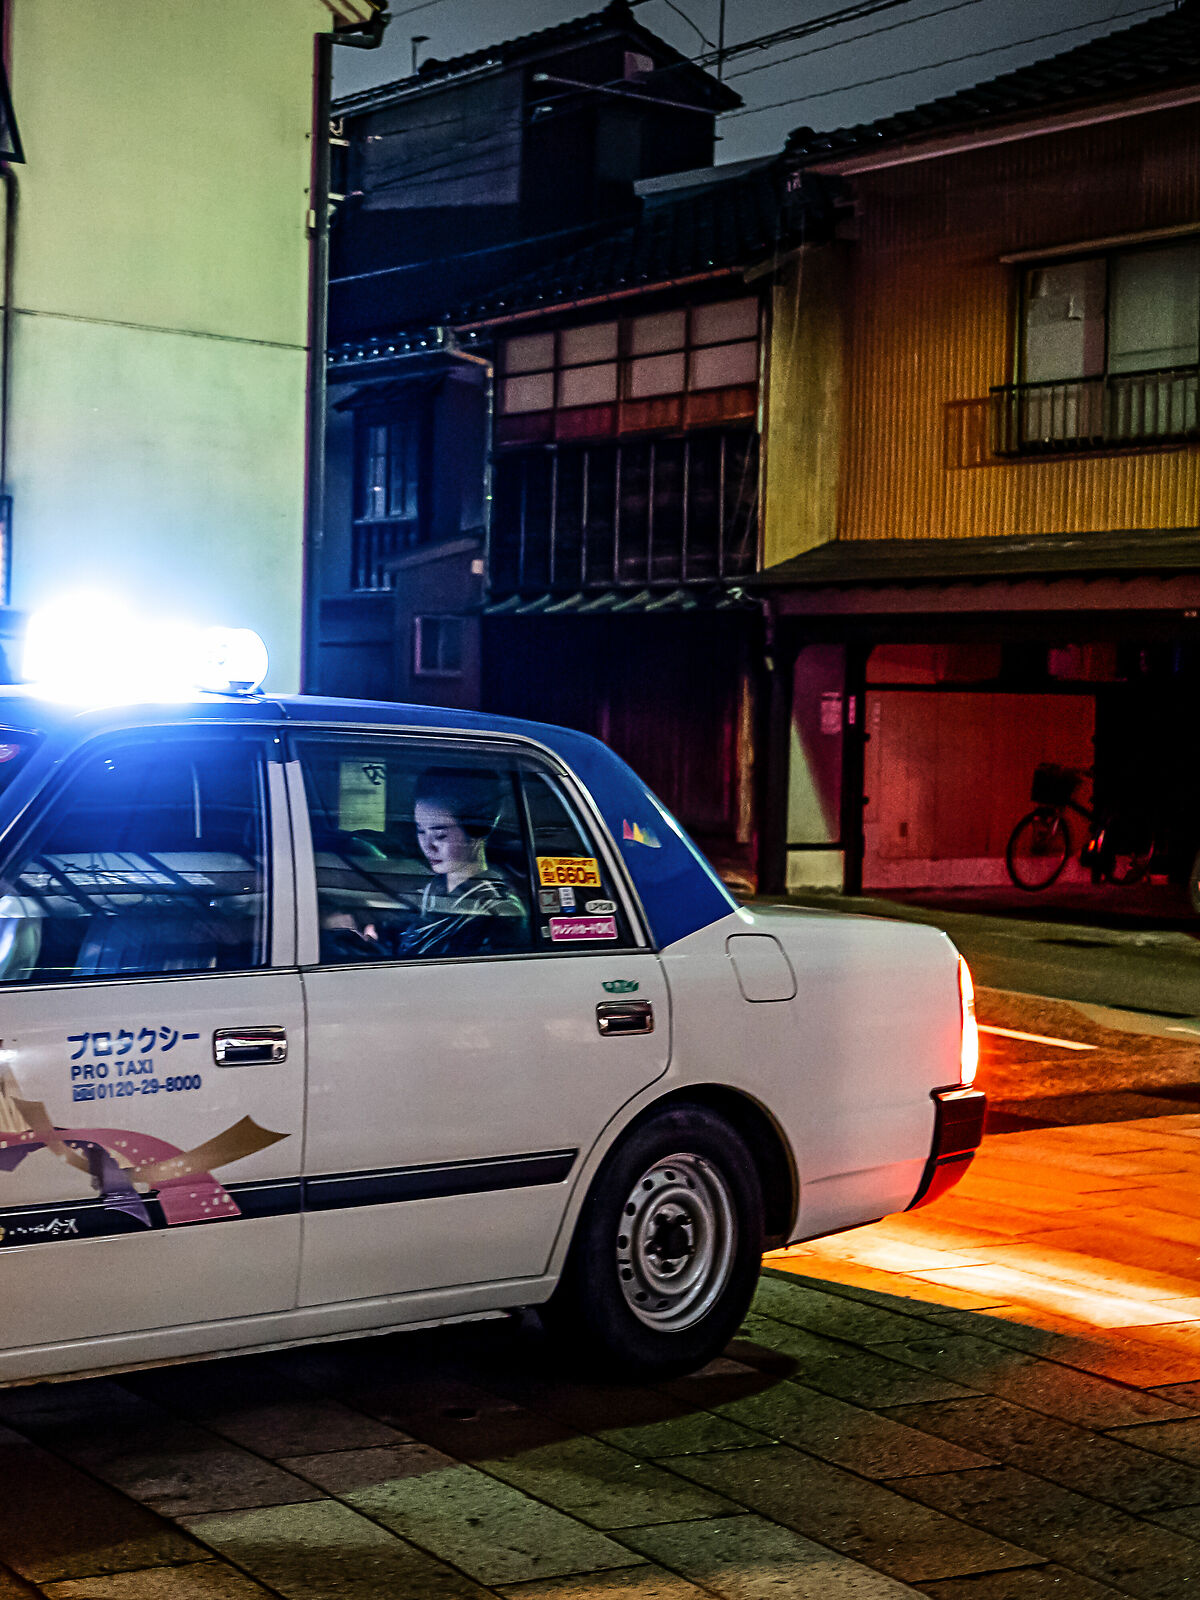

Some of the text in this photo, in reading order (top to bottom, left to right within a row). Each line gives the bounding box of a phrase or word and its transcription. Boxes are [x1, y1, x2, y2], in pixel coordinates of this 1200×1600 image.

[67, 1026, 200, 1060] プロタクシー
[71, 1059, 153, 1081] PRO TAXI
[97, 1074, 202, 1099] 0120-29-8000
